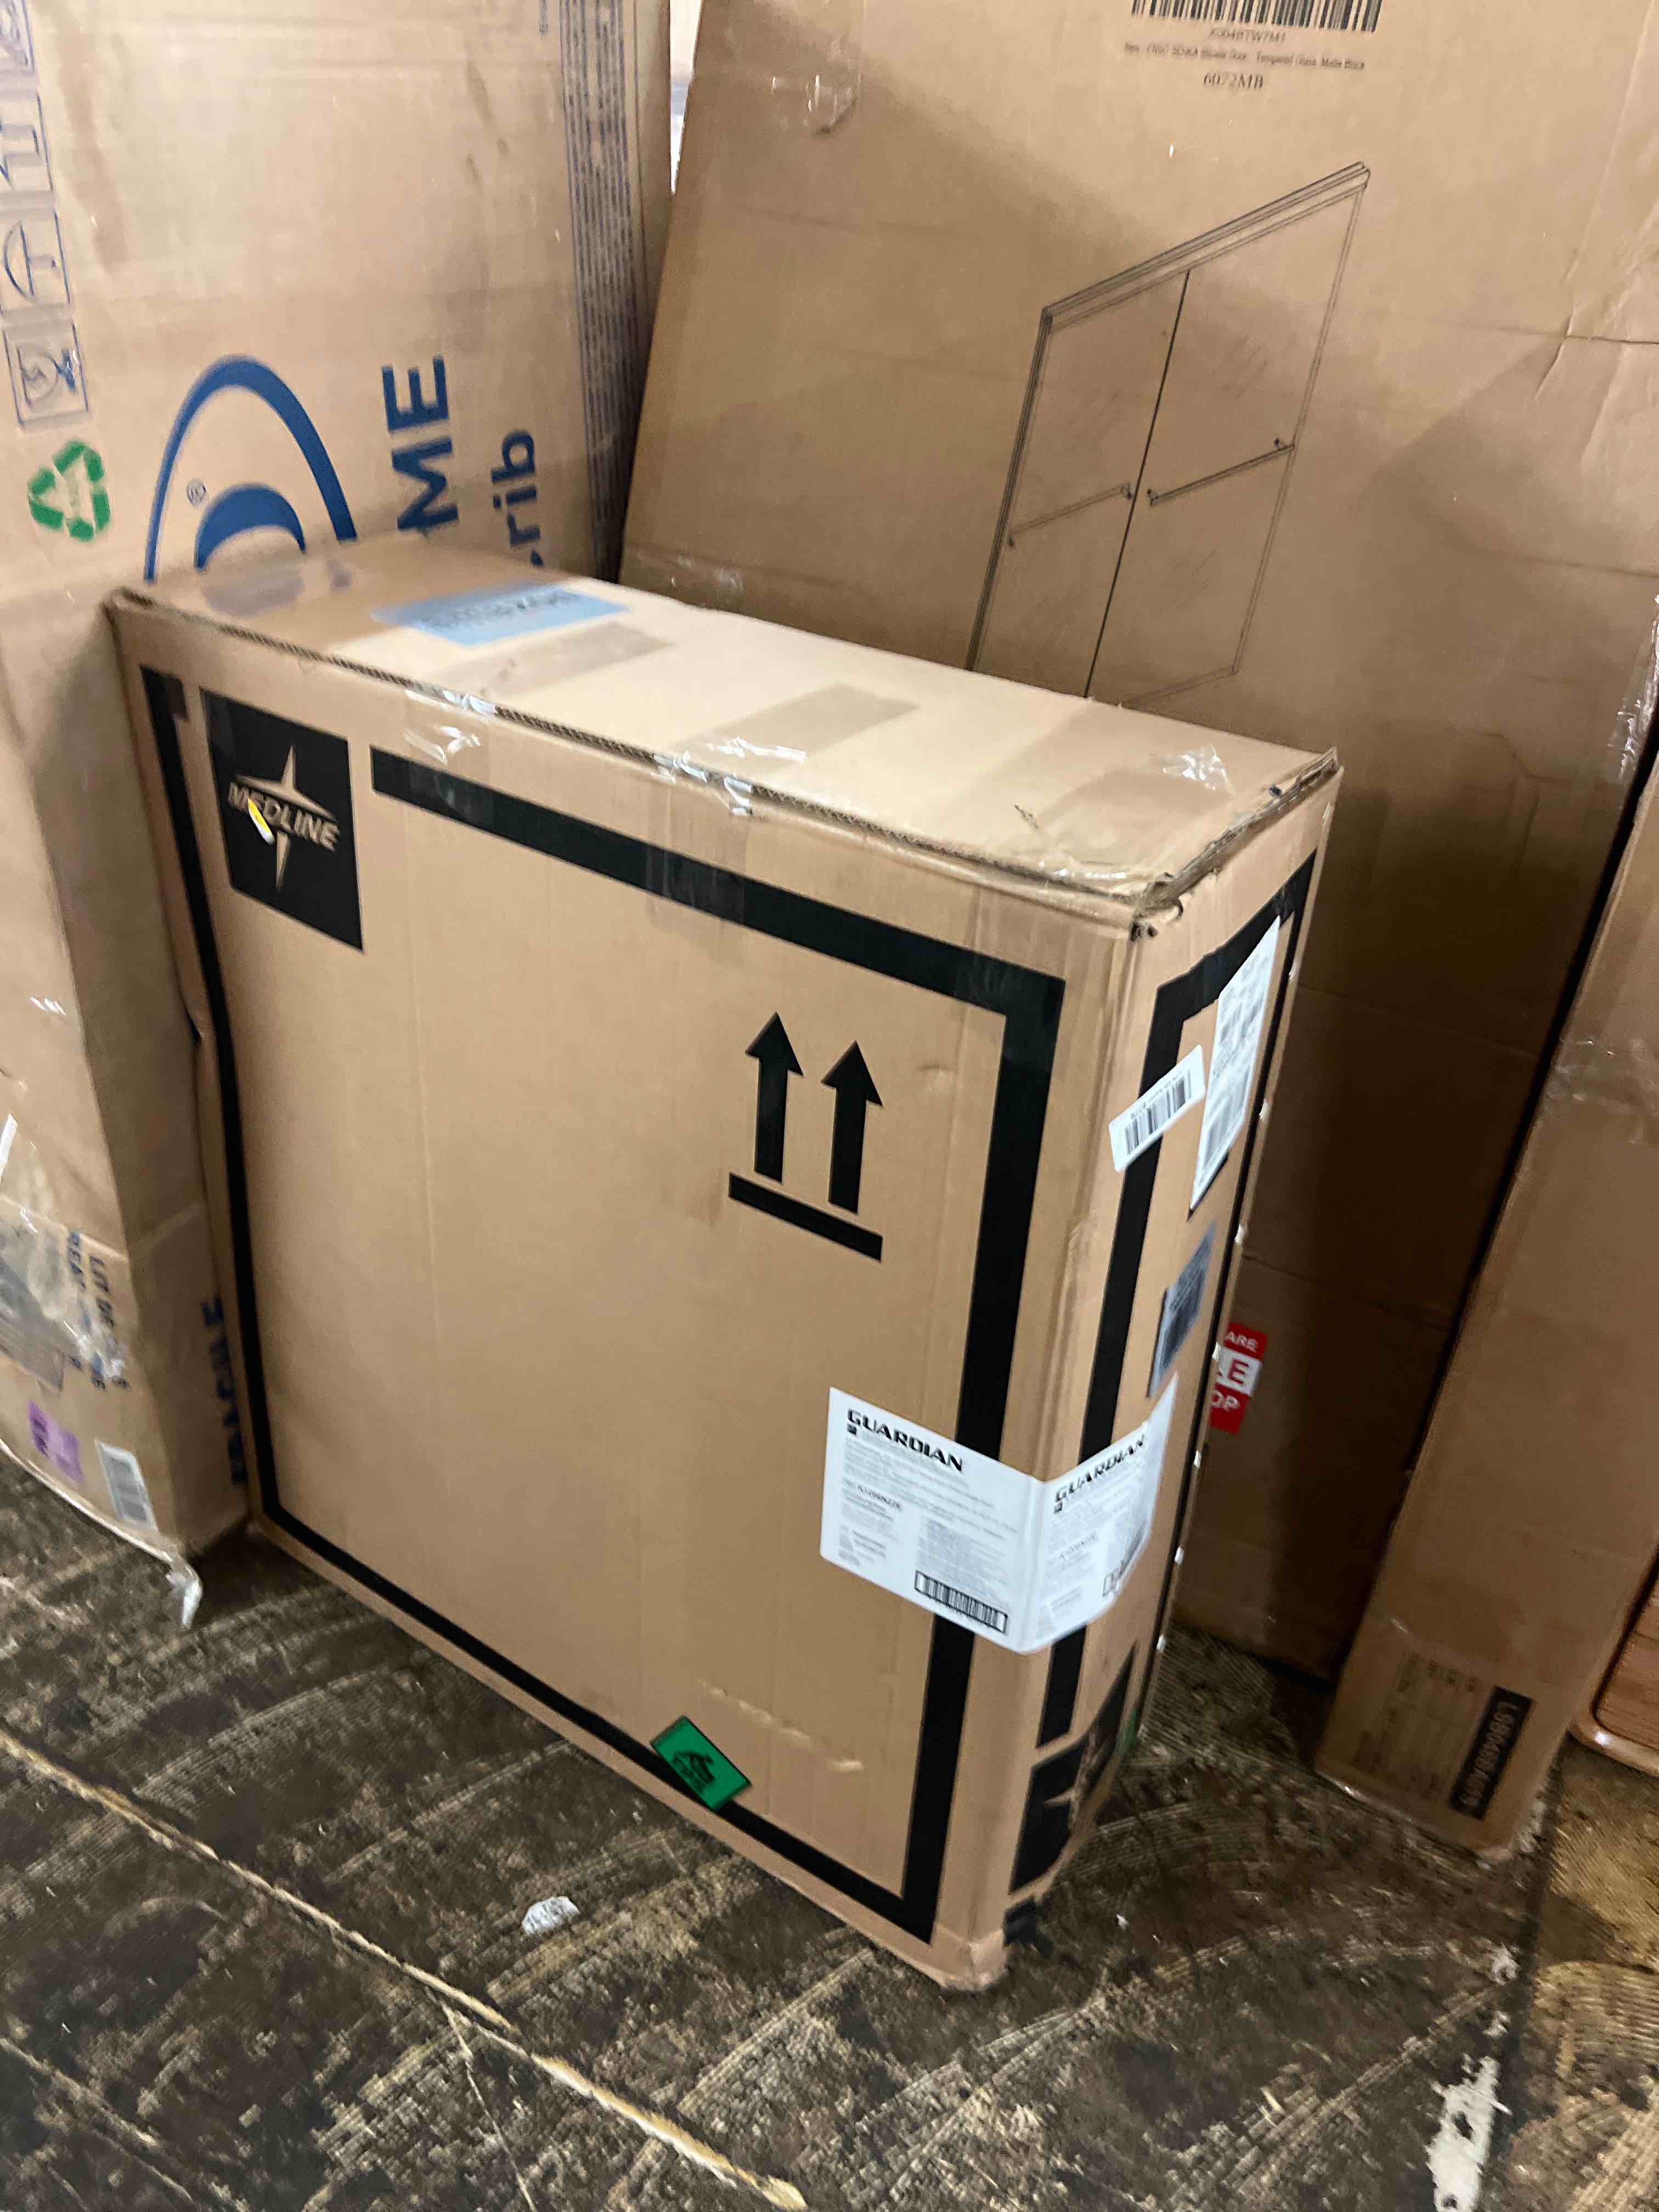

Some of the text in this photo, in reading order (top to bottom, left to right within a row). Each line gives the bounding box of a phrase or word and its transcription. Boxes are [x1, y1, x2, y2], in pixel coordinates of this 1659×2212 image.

[491, 429, 544, 567] rib
[847, 1408, 963, 1472] GUARDIAN
[1054, 1434, 1146, 1503] GUARDIAN
